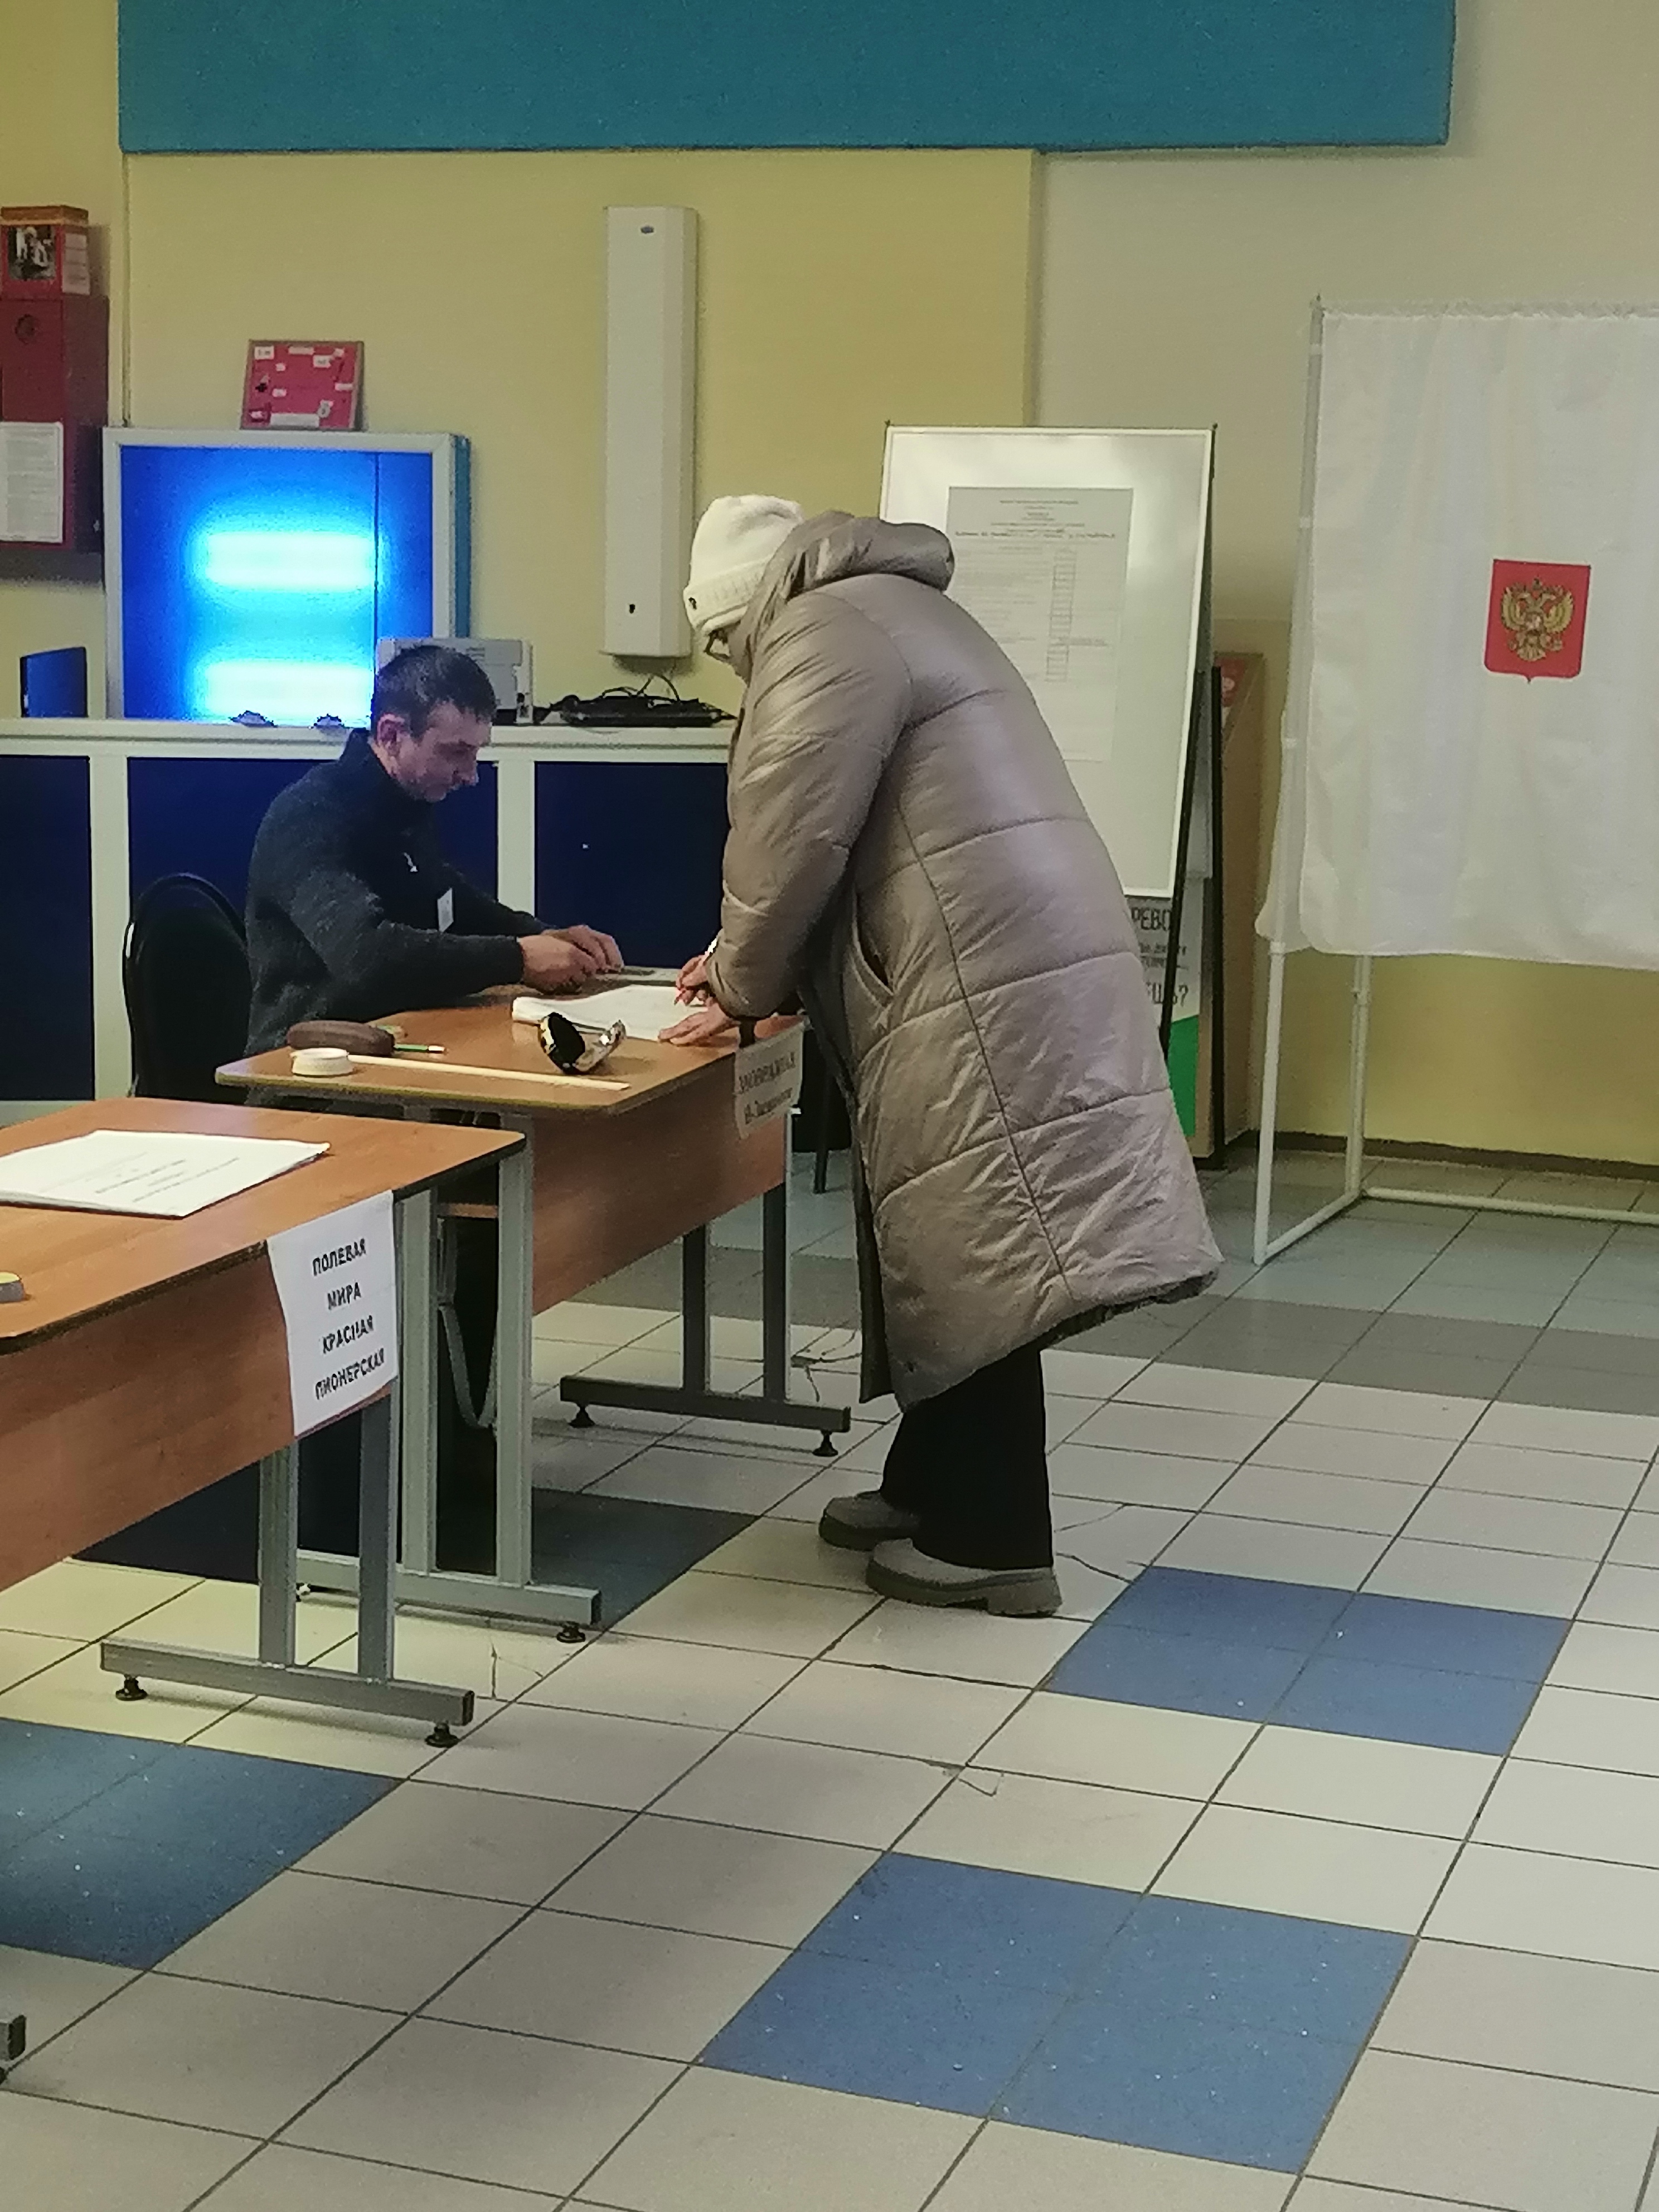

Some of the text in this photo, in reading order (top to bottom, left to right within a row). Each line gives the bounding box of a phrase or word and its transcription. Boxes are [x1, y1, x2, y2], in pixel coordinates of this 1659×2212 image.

[313, 1238, 366, 1276] ПОЛЕВАЯ
[328, 1282, 361, 1309] МИРА
[322, 1315, 373, 1354] КРАСНАЯ
[315, 1348, 384, 1400] ПИОНЕРСКАЯ
